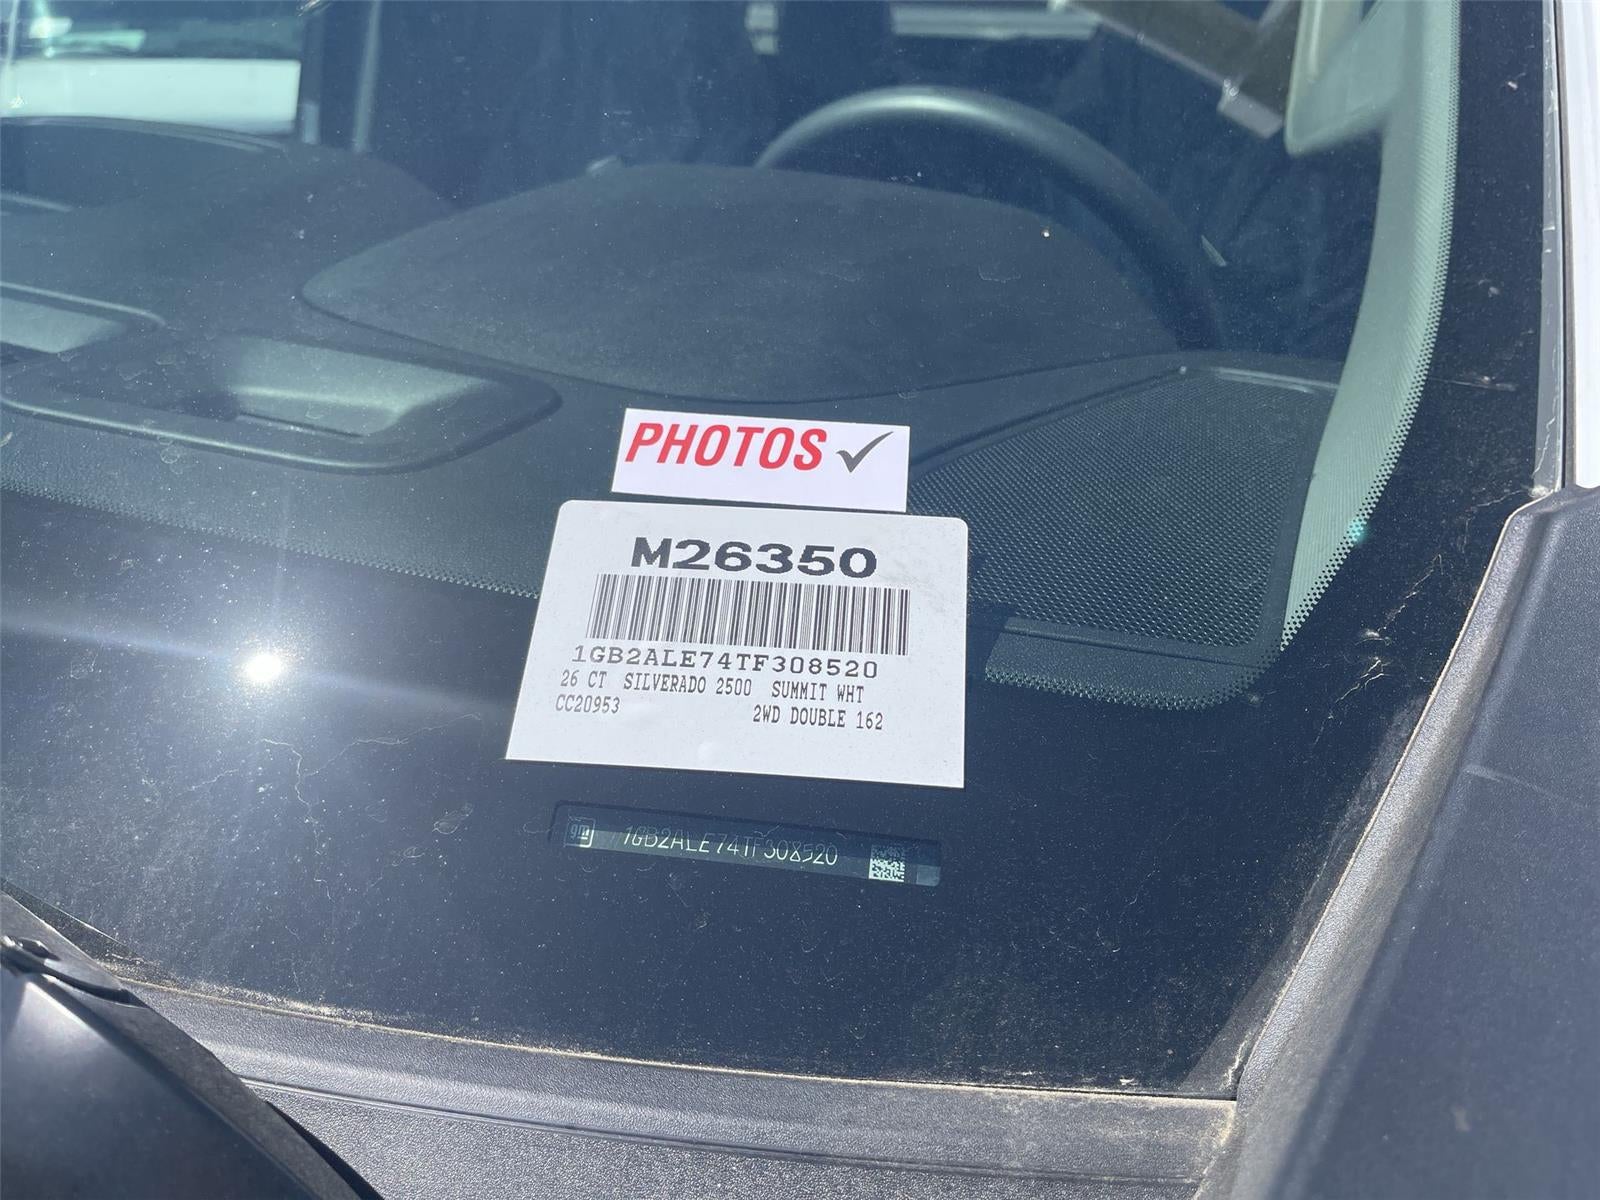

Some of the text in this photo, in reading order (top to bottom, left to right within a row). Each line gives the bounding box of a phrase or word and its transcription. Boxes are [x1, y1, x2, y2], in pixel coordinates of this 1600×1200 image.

[625, 422, 827, 471] PHOTOS
[631, 536, 878, 579] M26350
[571, 644, 878, 679] 1GB2ALE74TF308520
[555, 694, 621, 714] CC20953
[560, 670, 865, 704] 26 CT SILVERADO 2500 SUMMIT WHT
[753, 705, 884, 730] 2WD DOUBLE 162
